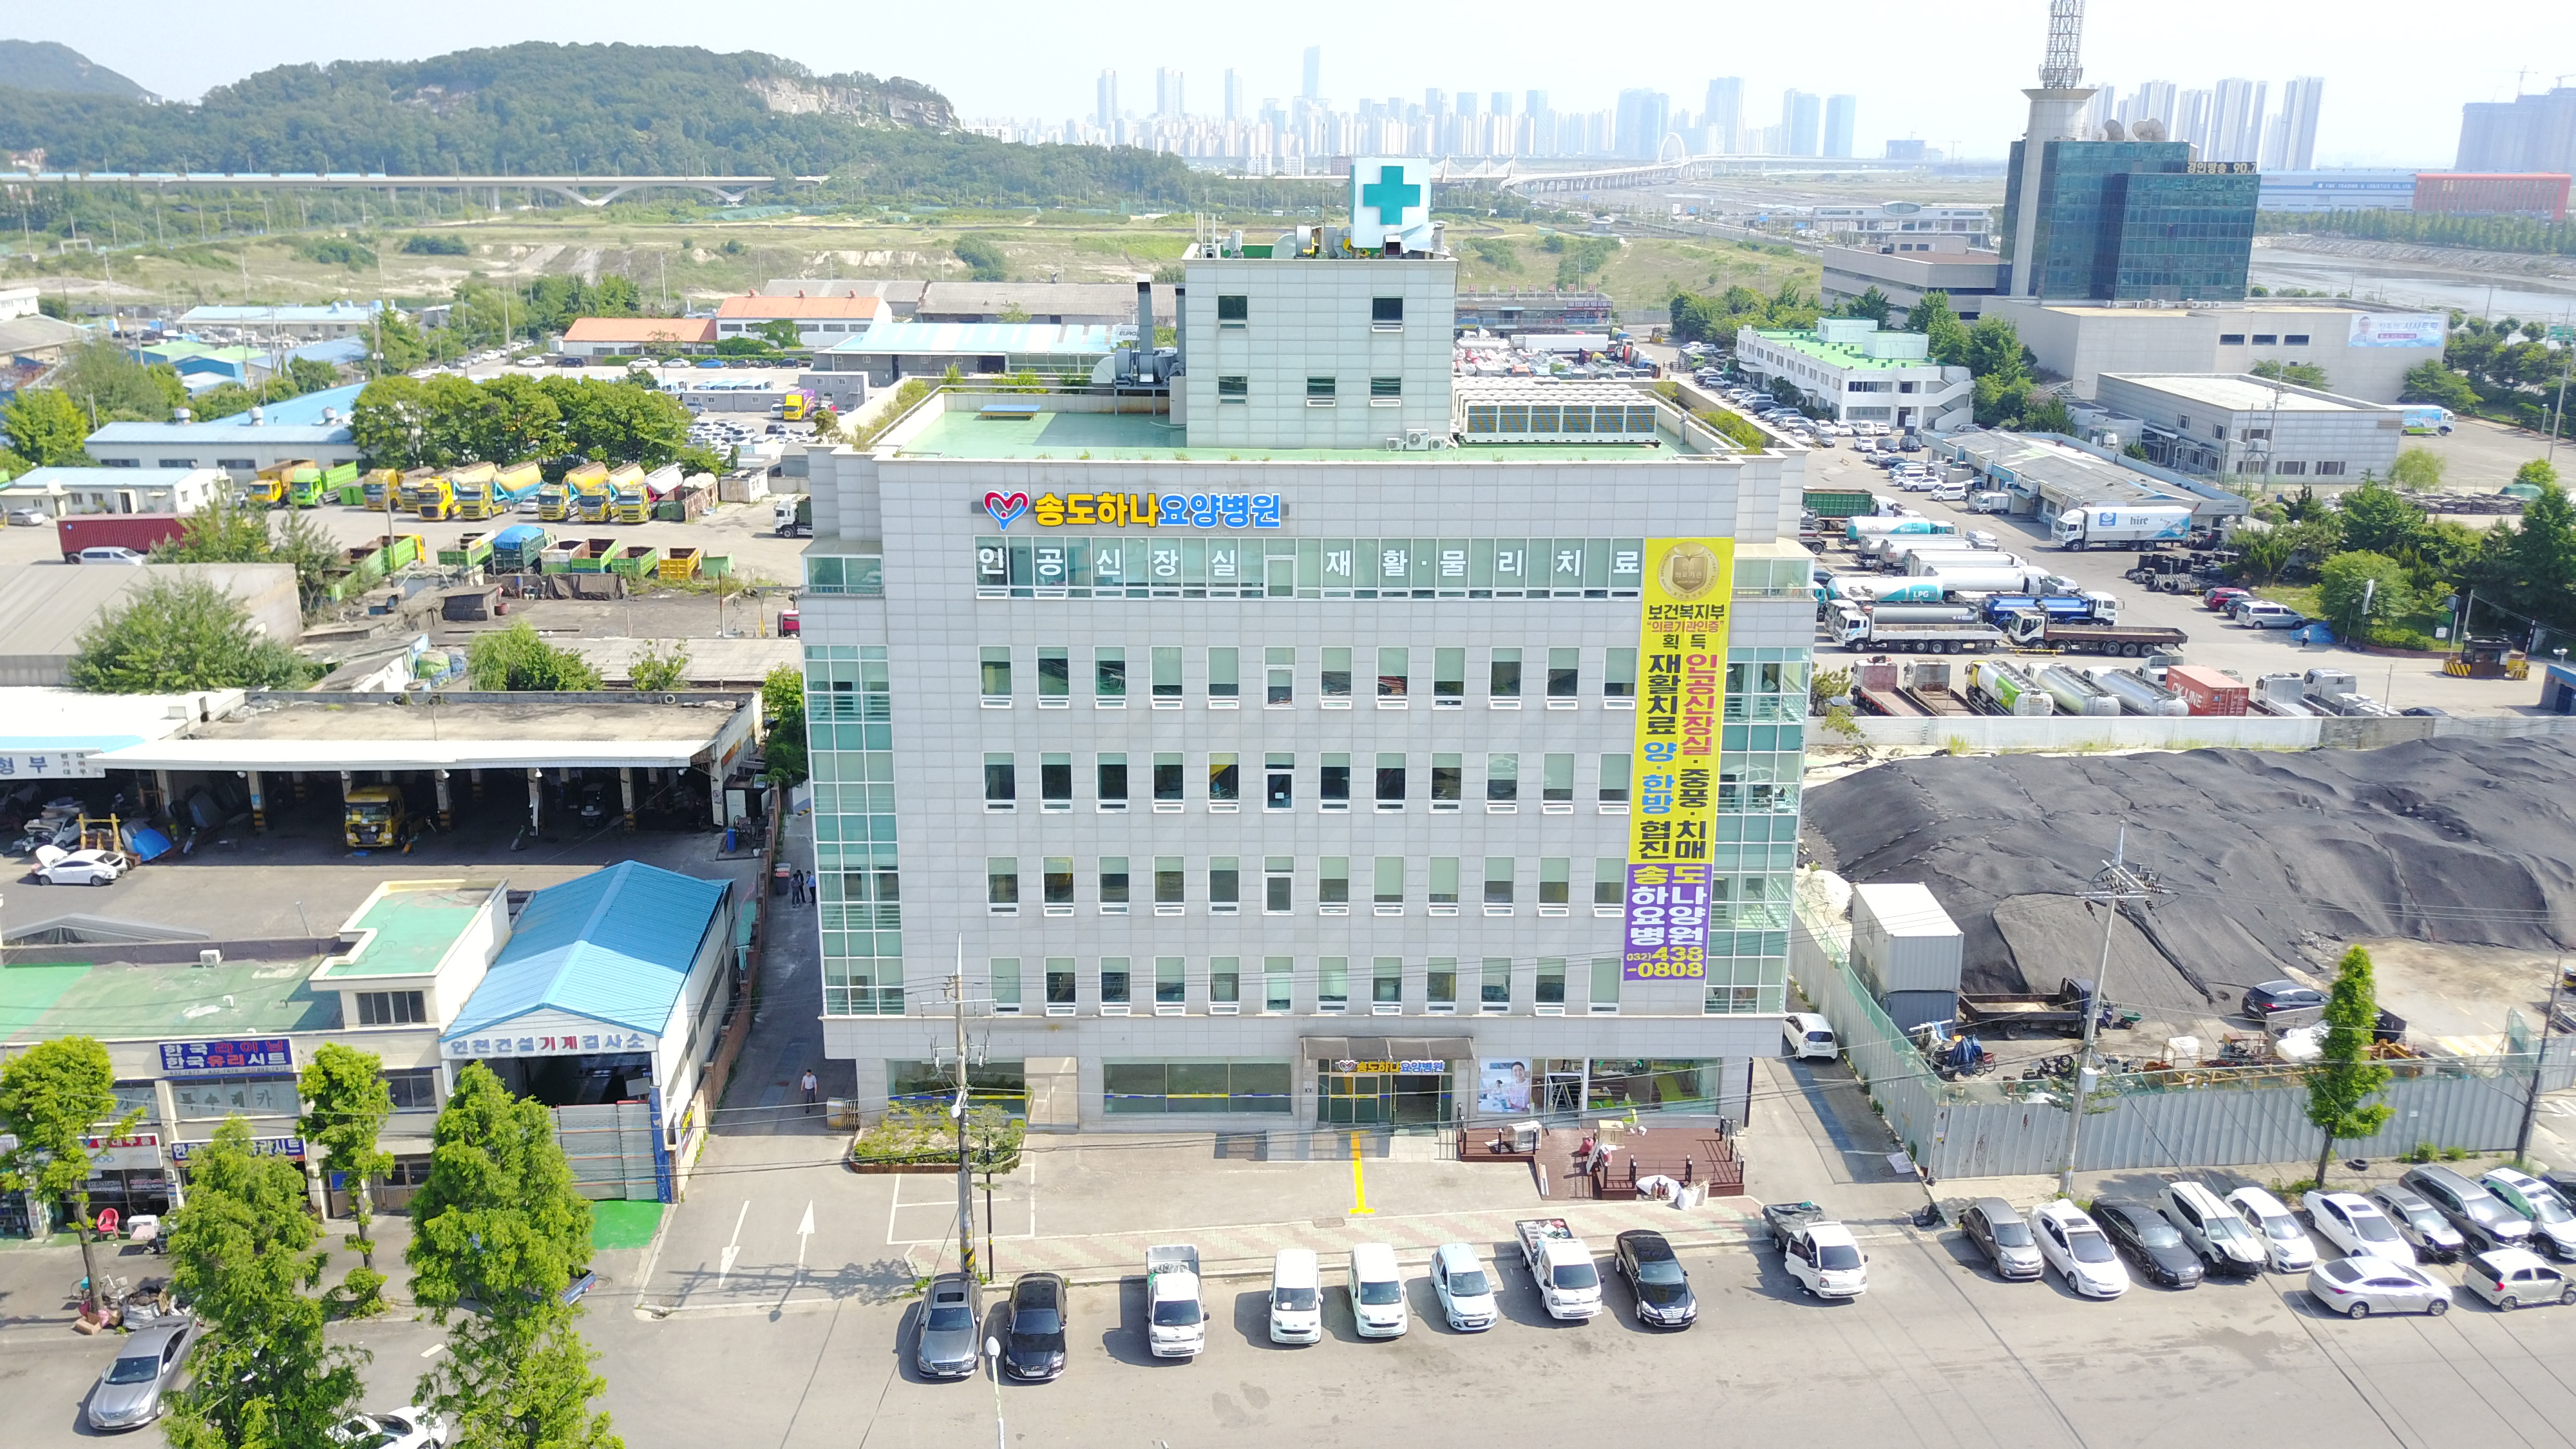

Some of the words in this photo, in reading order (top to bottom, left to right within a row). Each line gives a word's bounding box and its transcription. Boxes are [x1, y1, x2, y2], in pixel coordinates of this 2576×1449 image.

[2187, 162, 2227, 174] 경인방송
[2233, 162, 2257, 174] 90.7
[1034, 491, 1281, 529] 송도하나요양병원
[978, 548, 1236, 576] 인공신장실
[1648, 604, 1725, 620] 보건복지부
[1646, 654, 1681, 735] 재활치료
[2172, 683, 2184, 696] CK
[2185, 688, 2202, 708] LINE
[1638, 820, 1671, 860] 협진
[451, 1033, 645, 1056] 인천건설기계검사소
[166, 1052, 287, 1069] 한국유리시트
[1356, 1060, 1444, 1073] 송도하나요양병원
